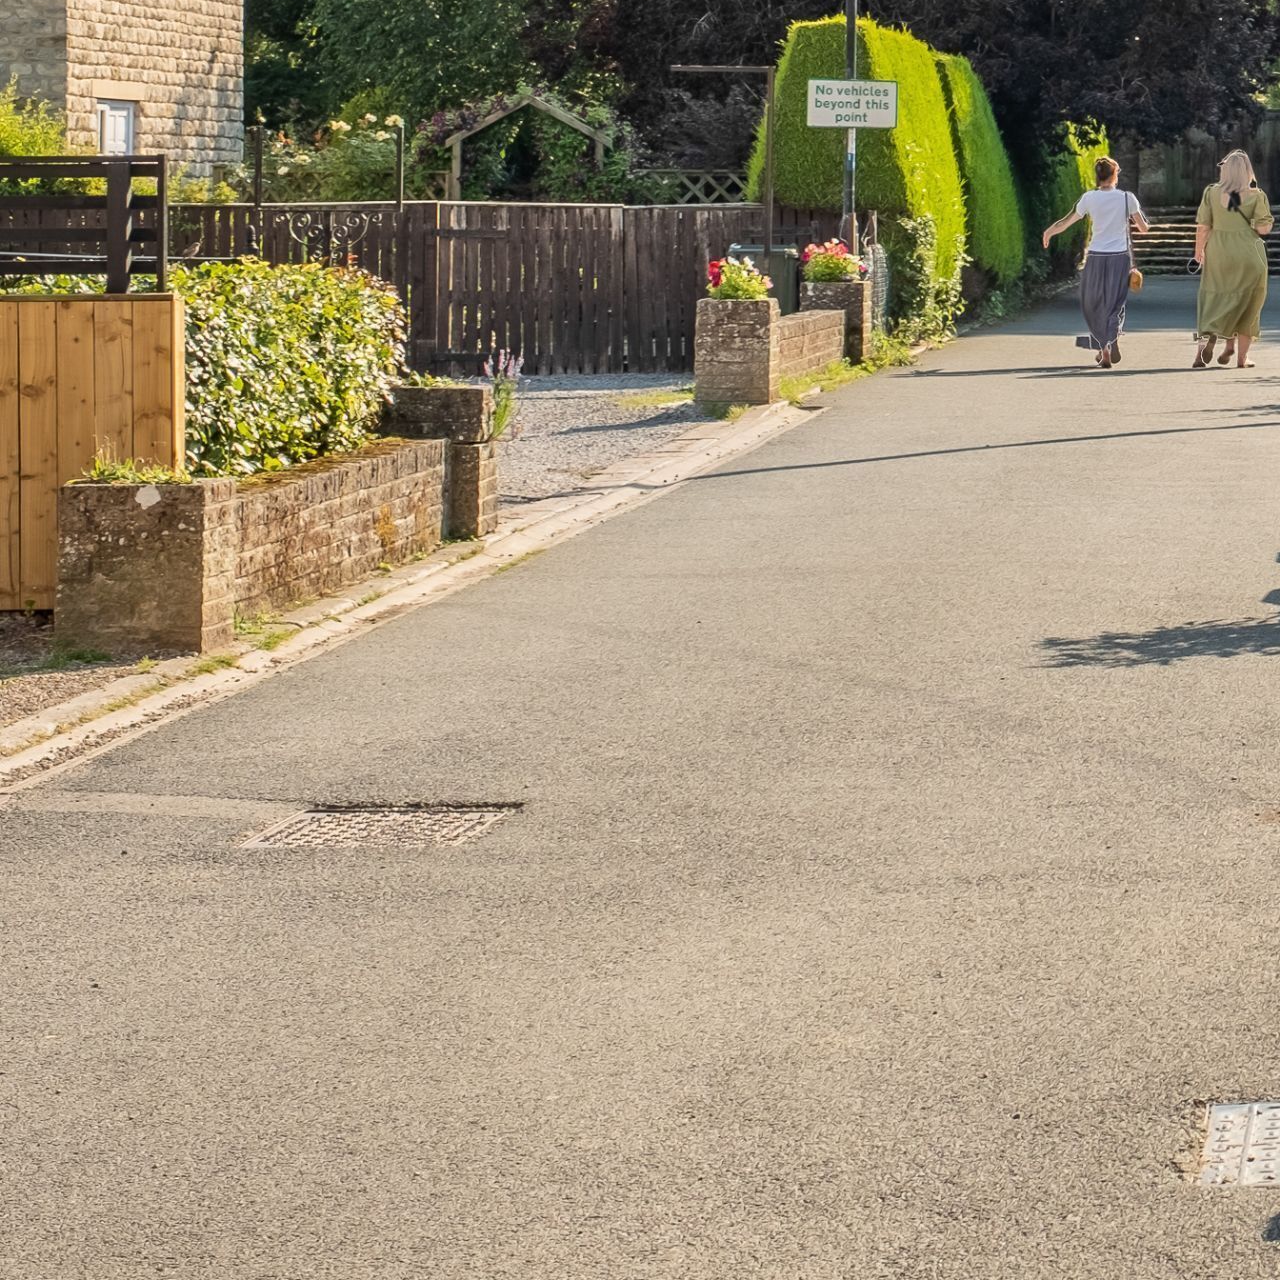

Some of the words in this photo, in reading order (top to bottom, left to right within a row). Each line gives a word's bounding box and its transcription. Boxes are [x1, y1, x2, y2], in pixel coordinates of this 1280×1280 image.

[815, 85, 833, 96] No
[836, 86, 889, 97] vehicles
[814, 98, 860, 111] beyond
[865, 99, 890, 110] this
[835, 112, 868, 124] point
